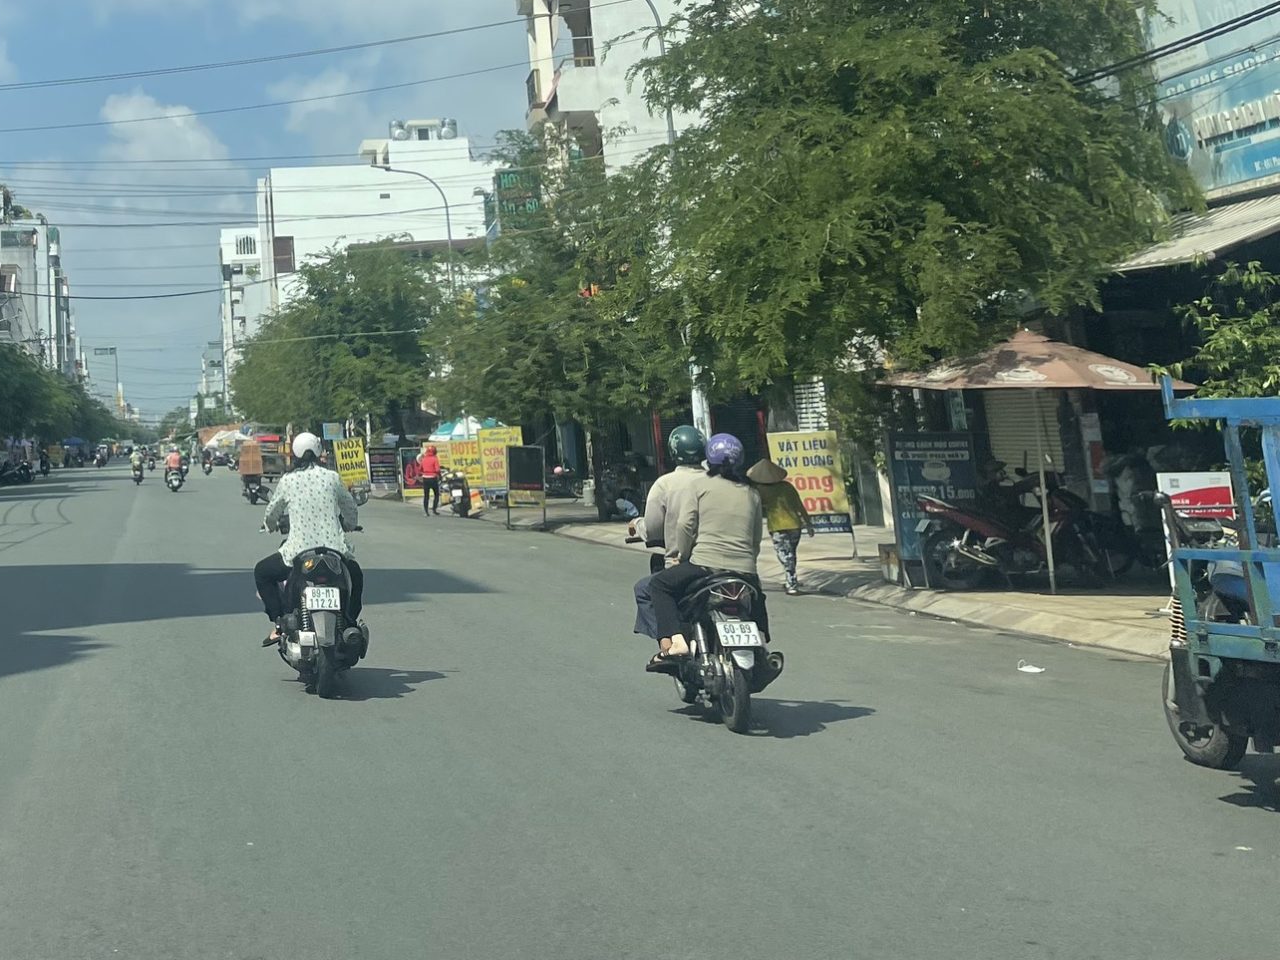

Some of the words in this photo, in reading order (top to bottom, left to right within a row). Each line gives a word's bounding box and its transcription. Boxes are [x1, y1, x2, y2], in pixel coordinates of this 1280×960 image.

[337, 439, 362, 451] INOX
[450, 441, 478, 456] HOTE
[777, 438, 799, 454] VẬT
[802, 437, 827, 453] LIỆU
[340, 450, 360, 460] HUY
[777, 454, 799, 468] XÂY
[803, 454, 834, 470] DỰNG
[309, 598, 339, 609] 112.24
[721, 634, 759, 645] 317.73
